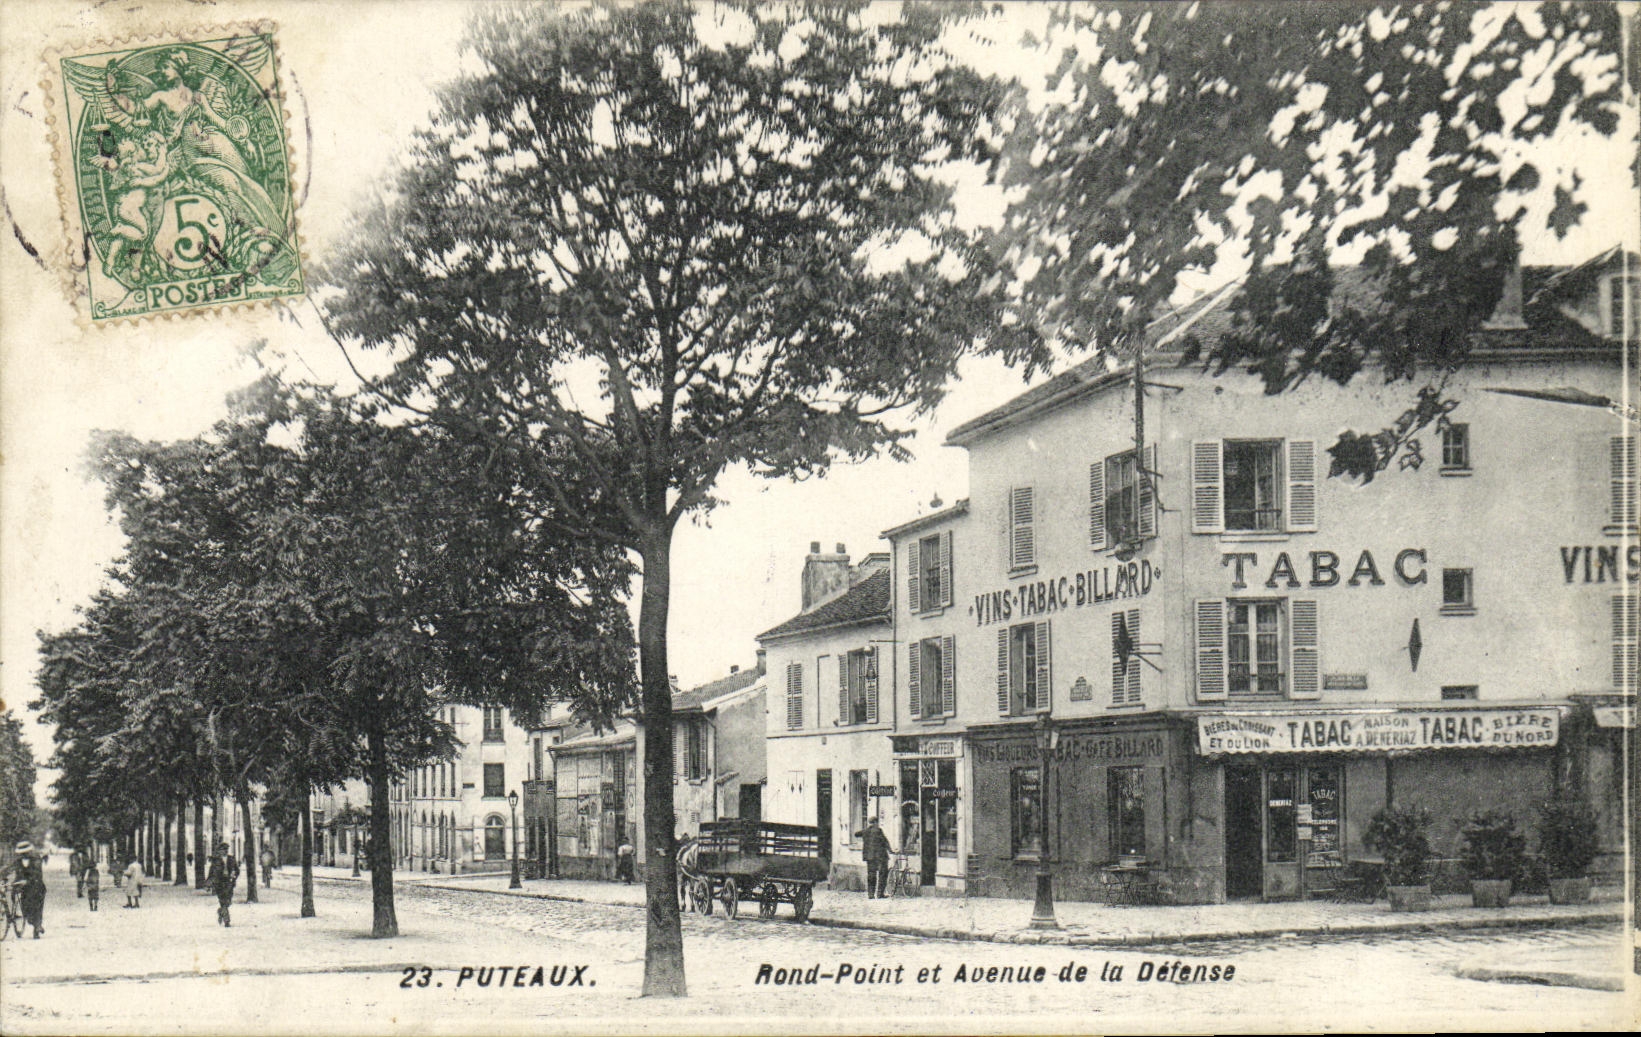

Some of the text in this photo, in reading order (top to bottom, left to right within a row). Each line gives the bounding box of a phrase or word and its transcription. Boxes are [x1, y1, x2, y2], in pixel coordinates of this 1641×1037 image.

[150, 275, 242, 308] POSTES
[1222, 548, 1429, 588] TABAC
[1560, 545, 1640, 583] VINS
[974, 559, 1153, 627] VINS TABAC BILLARD
[1287, 720, 1351, 748] TABAC
[1364, 716, 1409, 729] MAISON
[1420, 717, 1484, 744] TABAC
[1114, 736, 1164, 759] BILLARD
[1209, 737, 1223, 748] ET
[1244, 737, 1271, 749] LION
[1493, 730, 1554, 743] DU NORD
